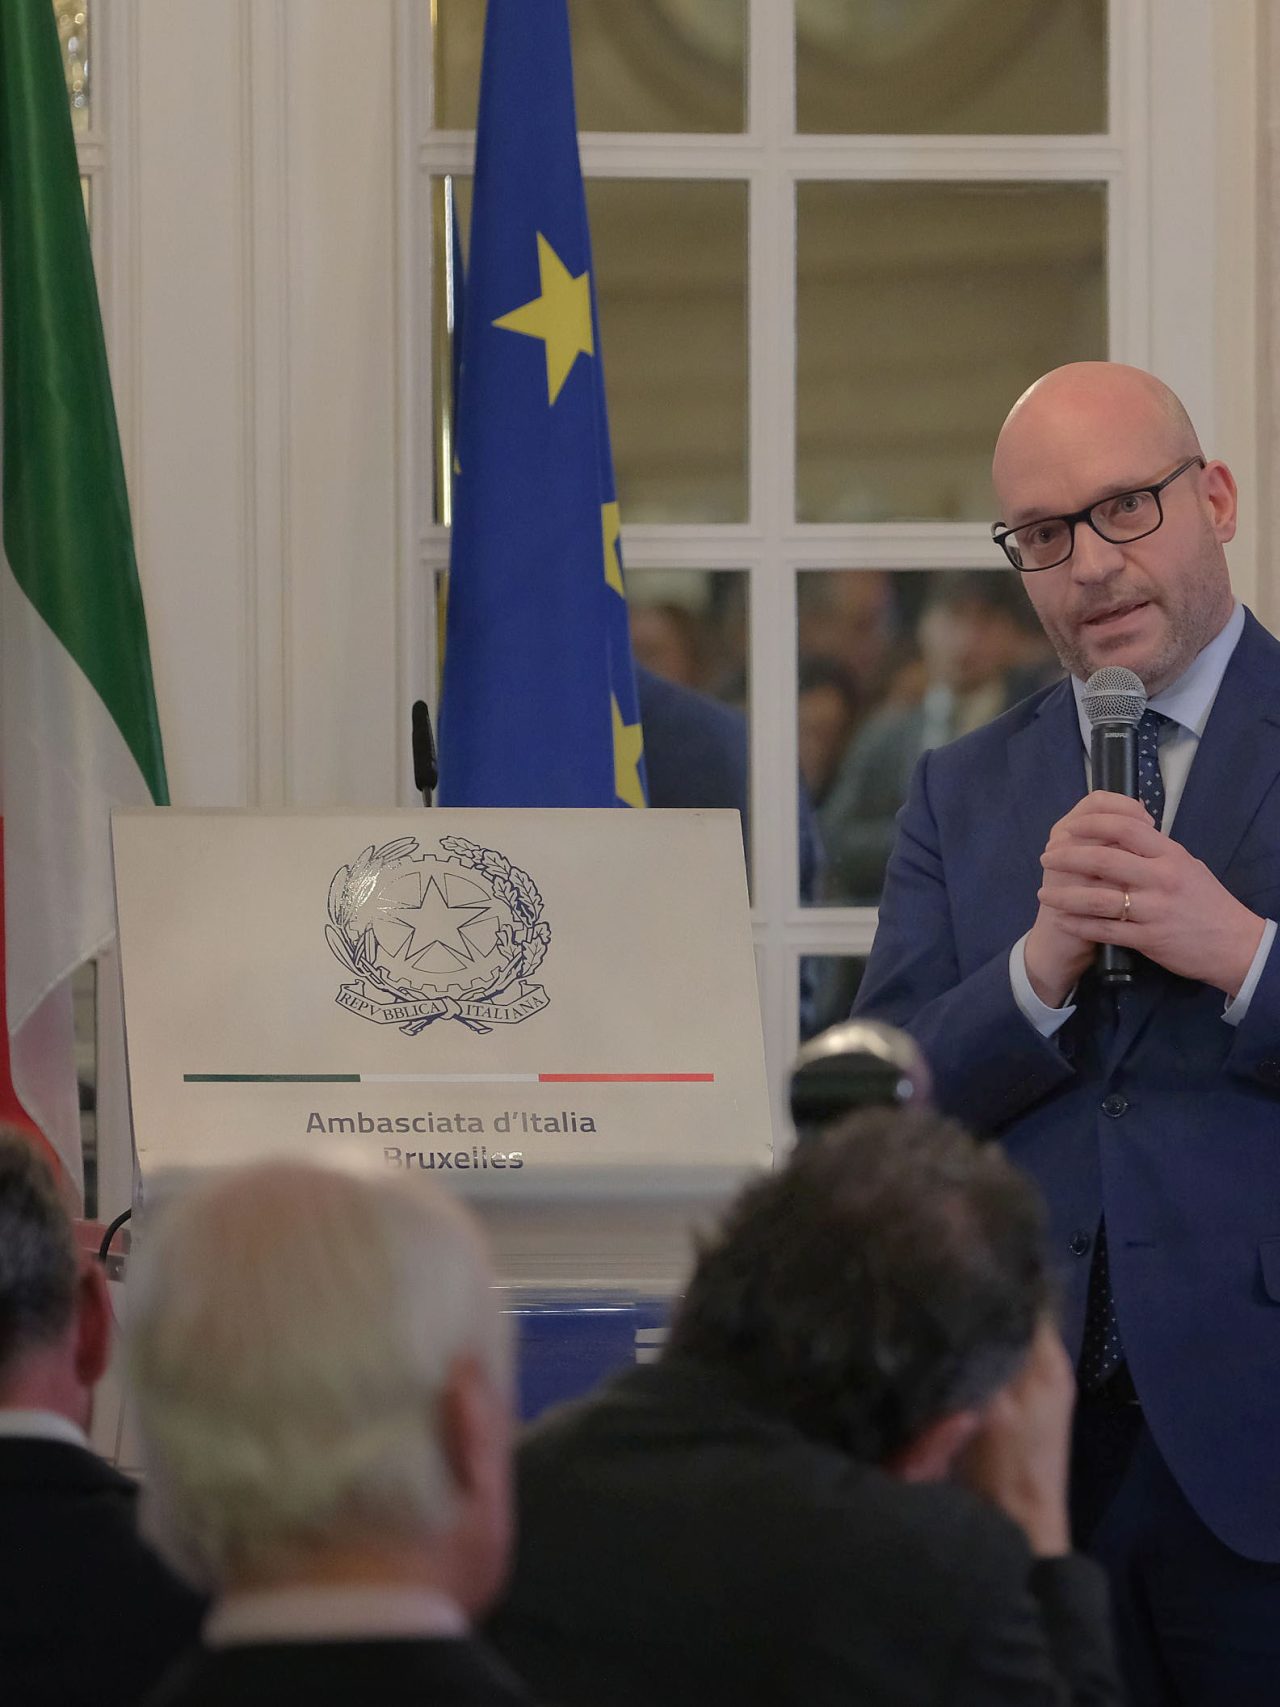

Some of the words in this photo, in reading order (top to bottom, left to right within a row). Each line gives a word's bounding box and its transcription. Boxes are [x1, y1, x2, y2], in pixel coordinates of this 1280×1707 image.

[465, 996, 545, 1020] ITALIANA
[306, 1112, 484, 1133] Ambasciata
[383, 1146, 524, 1169] Bruxelles
